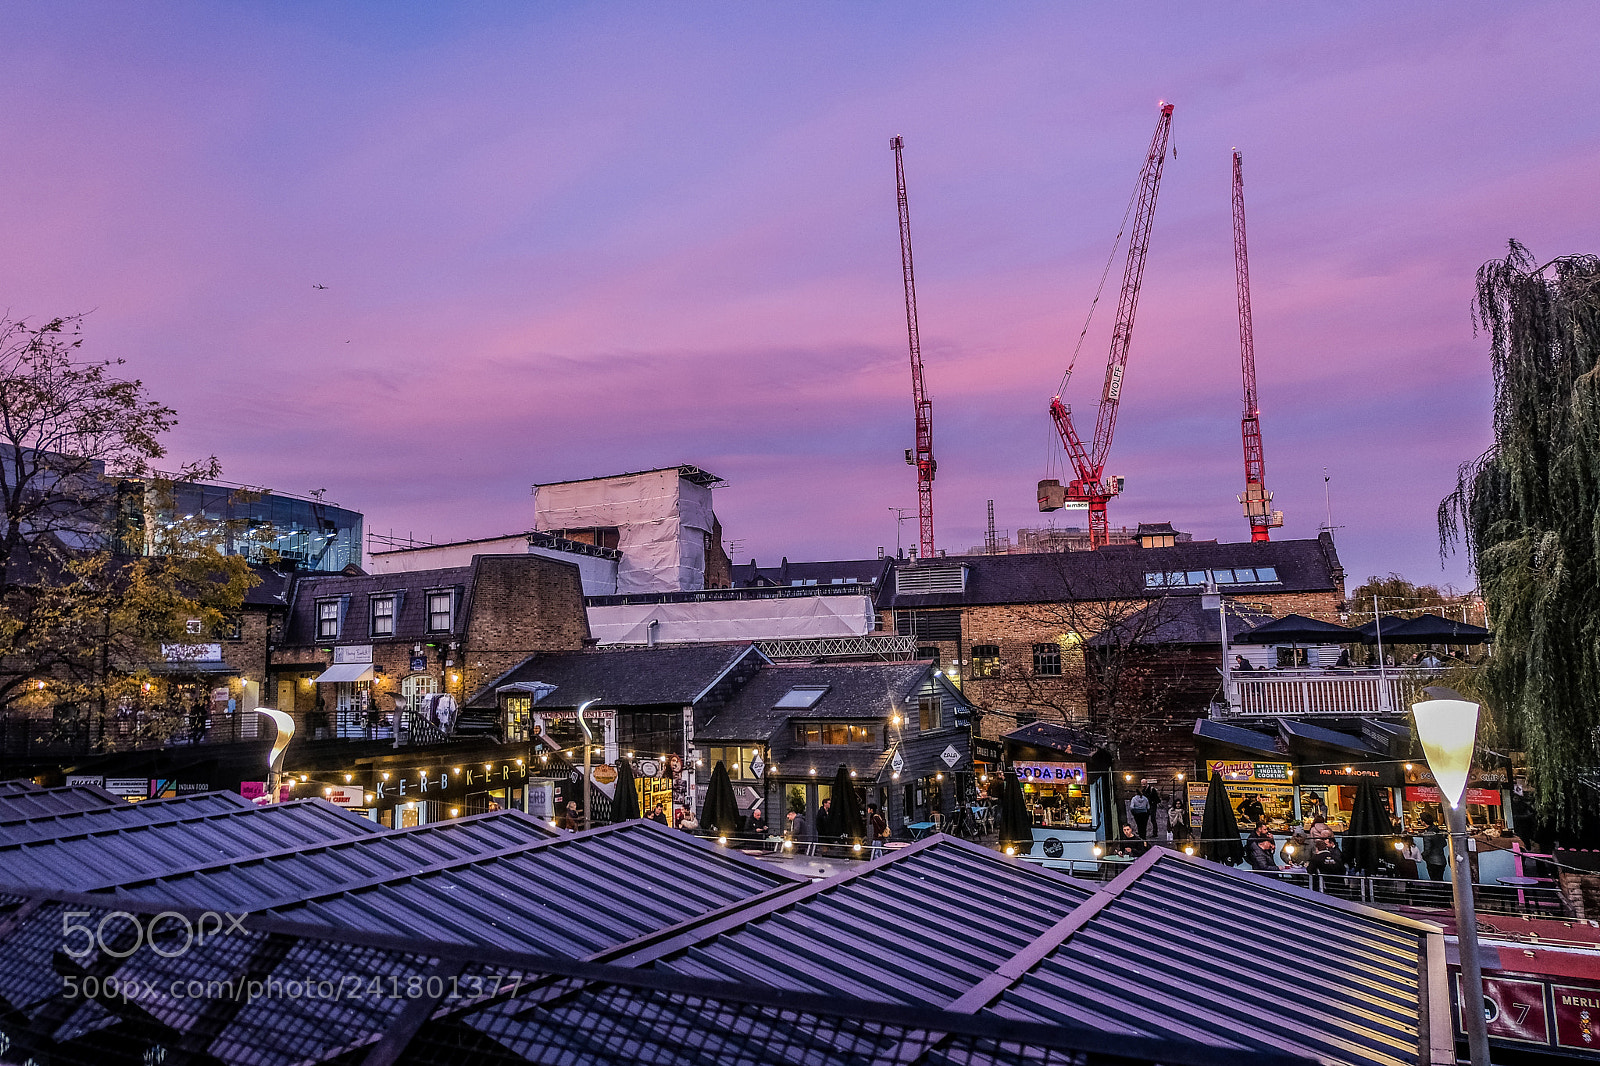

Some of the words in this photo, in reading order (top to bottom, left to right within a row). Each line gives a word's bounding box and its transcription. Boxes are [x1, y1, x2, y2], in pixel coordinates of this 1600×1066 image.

[1110, 366, 1123, 398] WOLFF
[1016, 767, 1052, 779] SODA
[178, 783, 195, 791] INDIAN
[529, 791, 546, 804] ERB
[1561, 995, 1600, 1009] MERLI
[1512, 1002, 1531, 1025] 7
